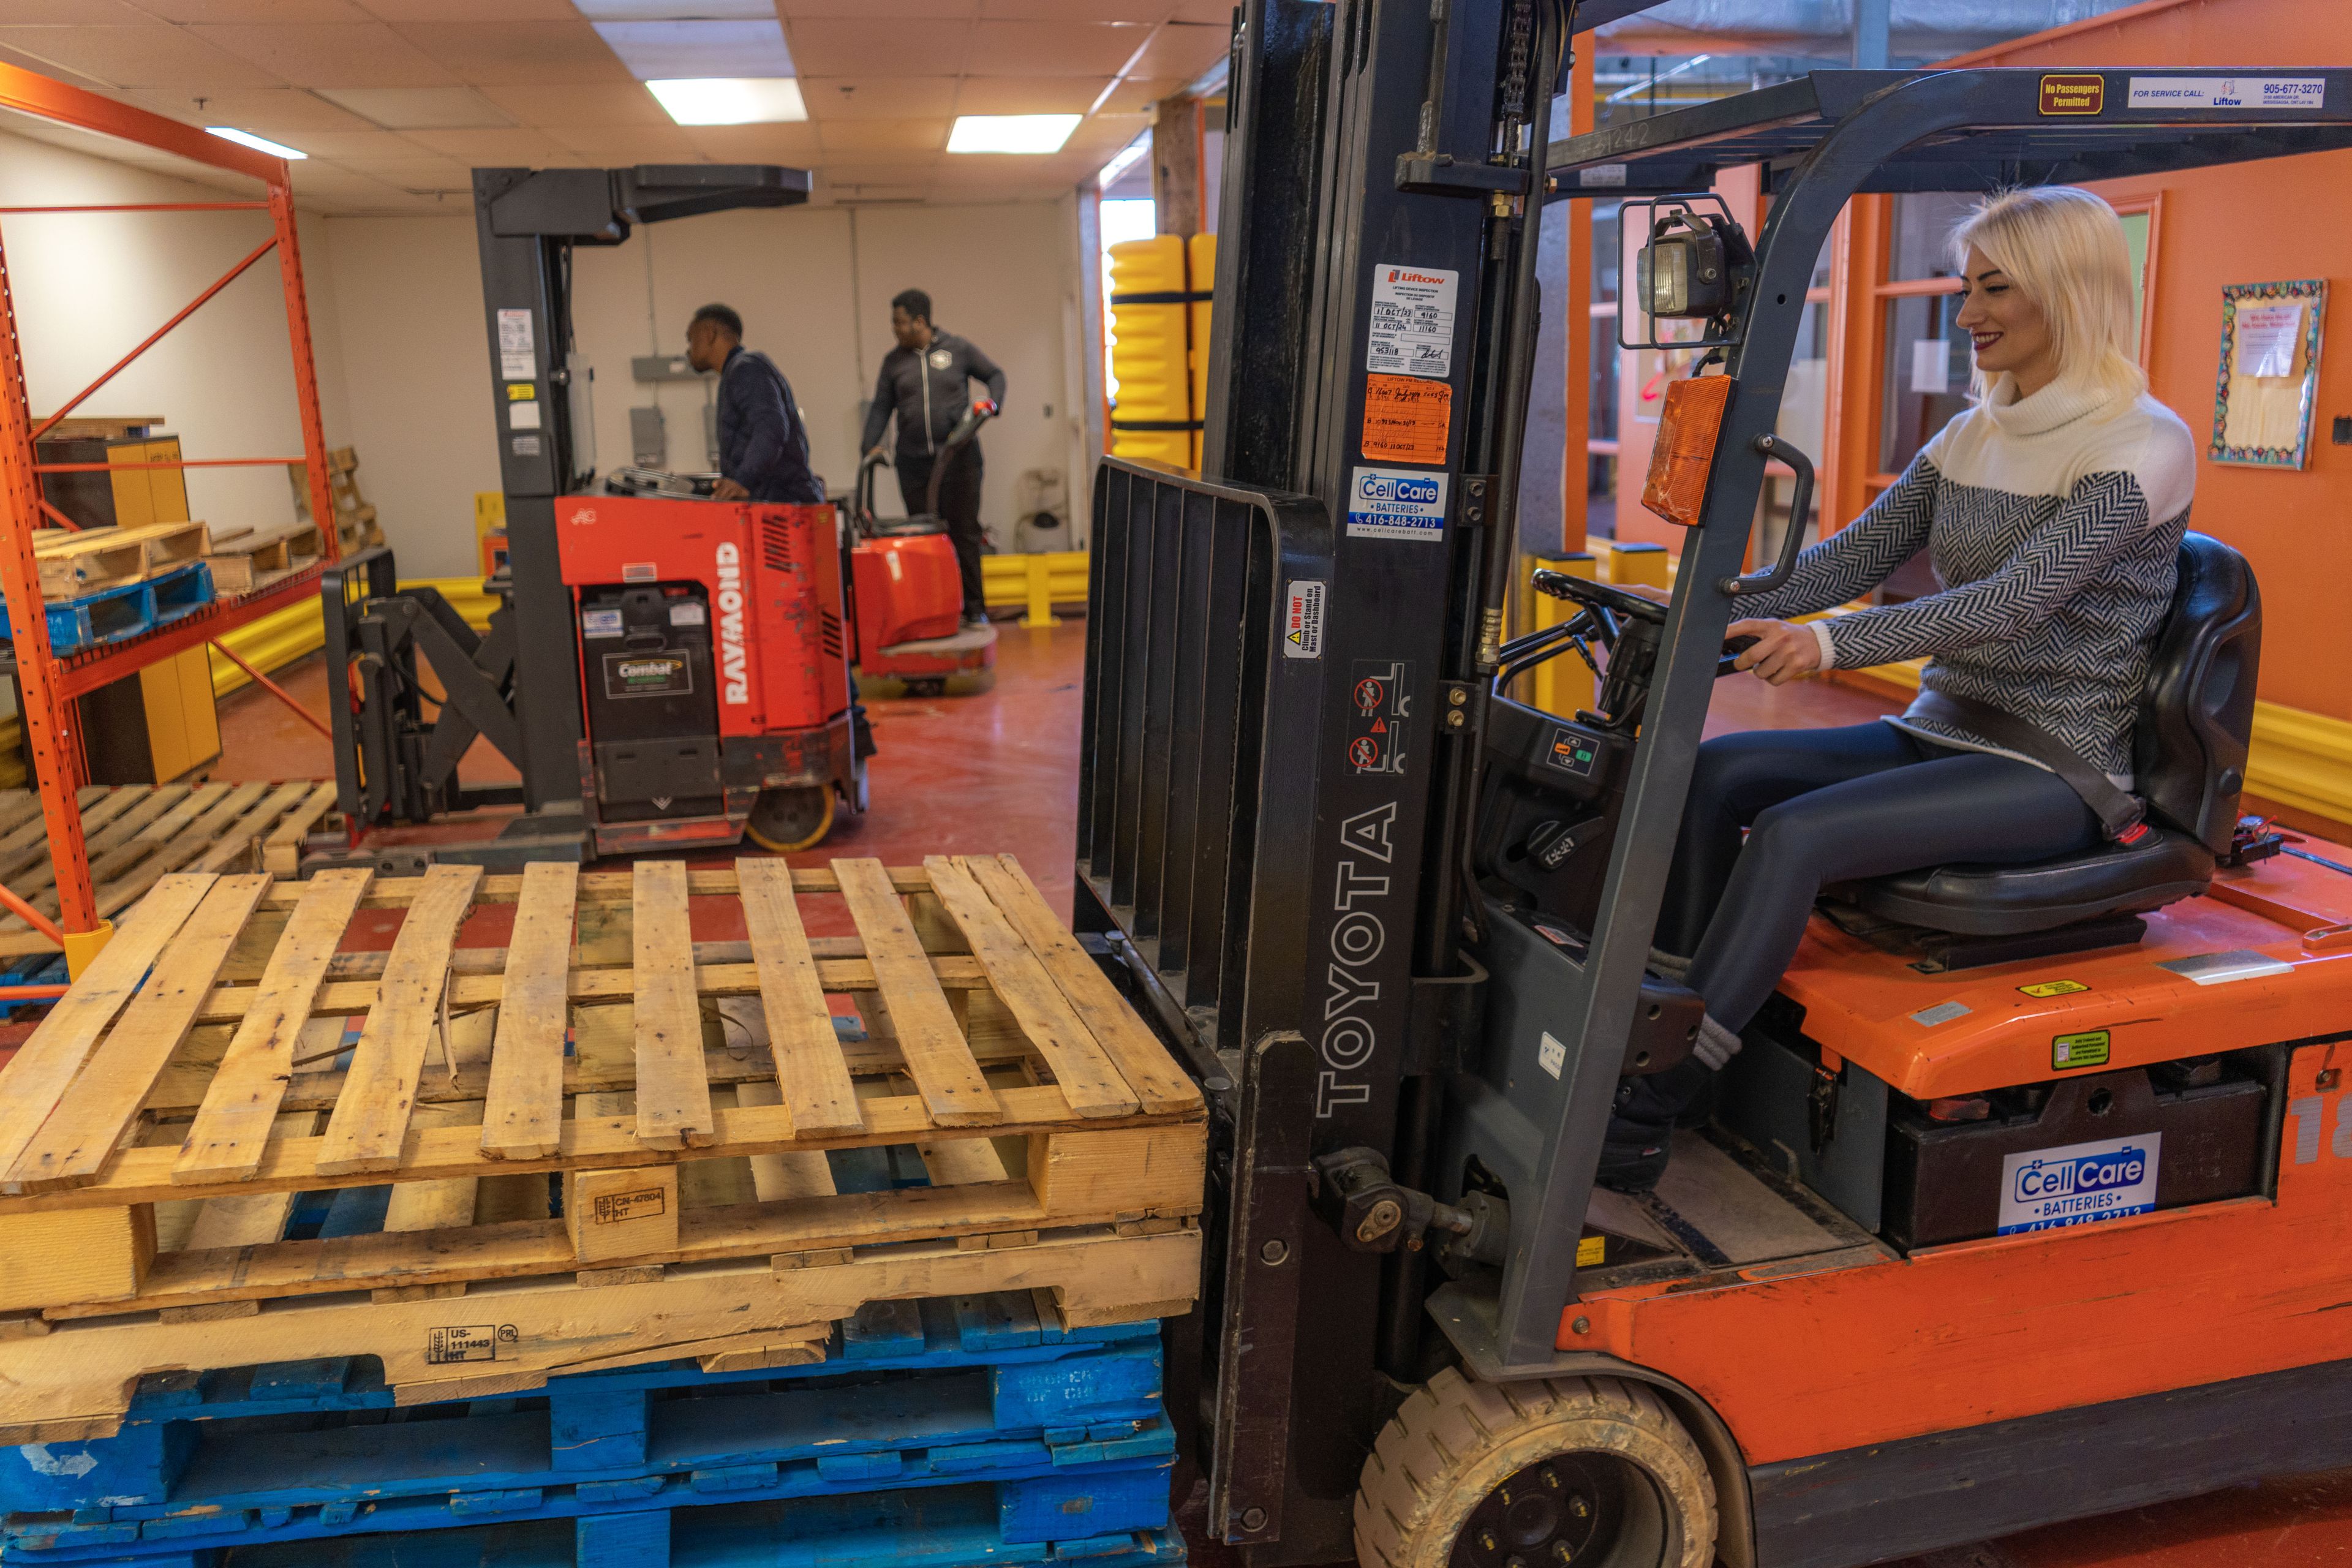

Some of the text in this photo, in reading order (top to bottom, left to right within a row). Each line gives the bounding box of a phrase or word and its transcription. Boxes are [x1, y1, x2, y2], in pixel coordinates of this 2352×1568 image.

[2046, 84, 2100, 95] No Passengers
[2264, 84, 2323, 94] 905-677-3270
[2054, 97, 2090, 107] Permitted
[2213, 97, 2242, 106] Liftow
[1401, 273, 1445, 285] Liftow
[1376, 503, 1419, 514] BATTERIES
[1365, 514, 1436, 528] 416-848-2713
[1357, 527, 1433, 536] www.cellcarebatt.com
[1307, 588, 1313, 597] on
[1311, 586, 1321, 624] Dashboard
[1291, 596, 1302, 628] DO NOT
[716, 541, 748, 704] RAYMOND
[618, 662, 673, 677] Combat
[1316, 801, 1396, 1118] TOYOTA
[2043, 1193, 2113, 1216] BATTERIES
[614, 1207, 630, 1217] HT
[451, 1330, 471, 1338] US-
[451, 1340, 489, 1349] 111443
